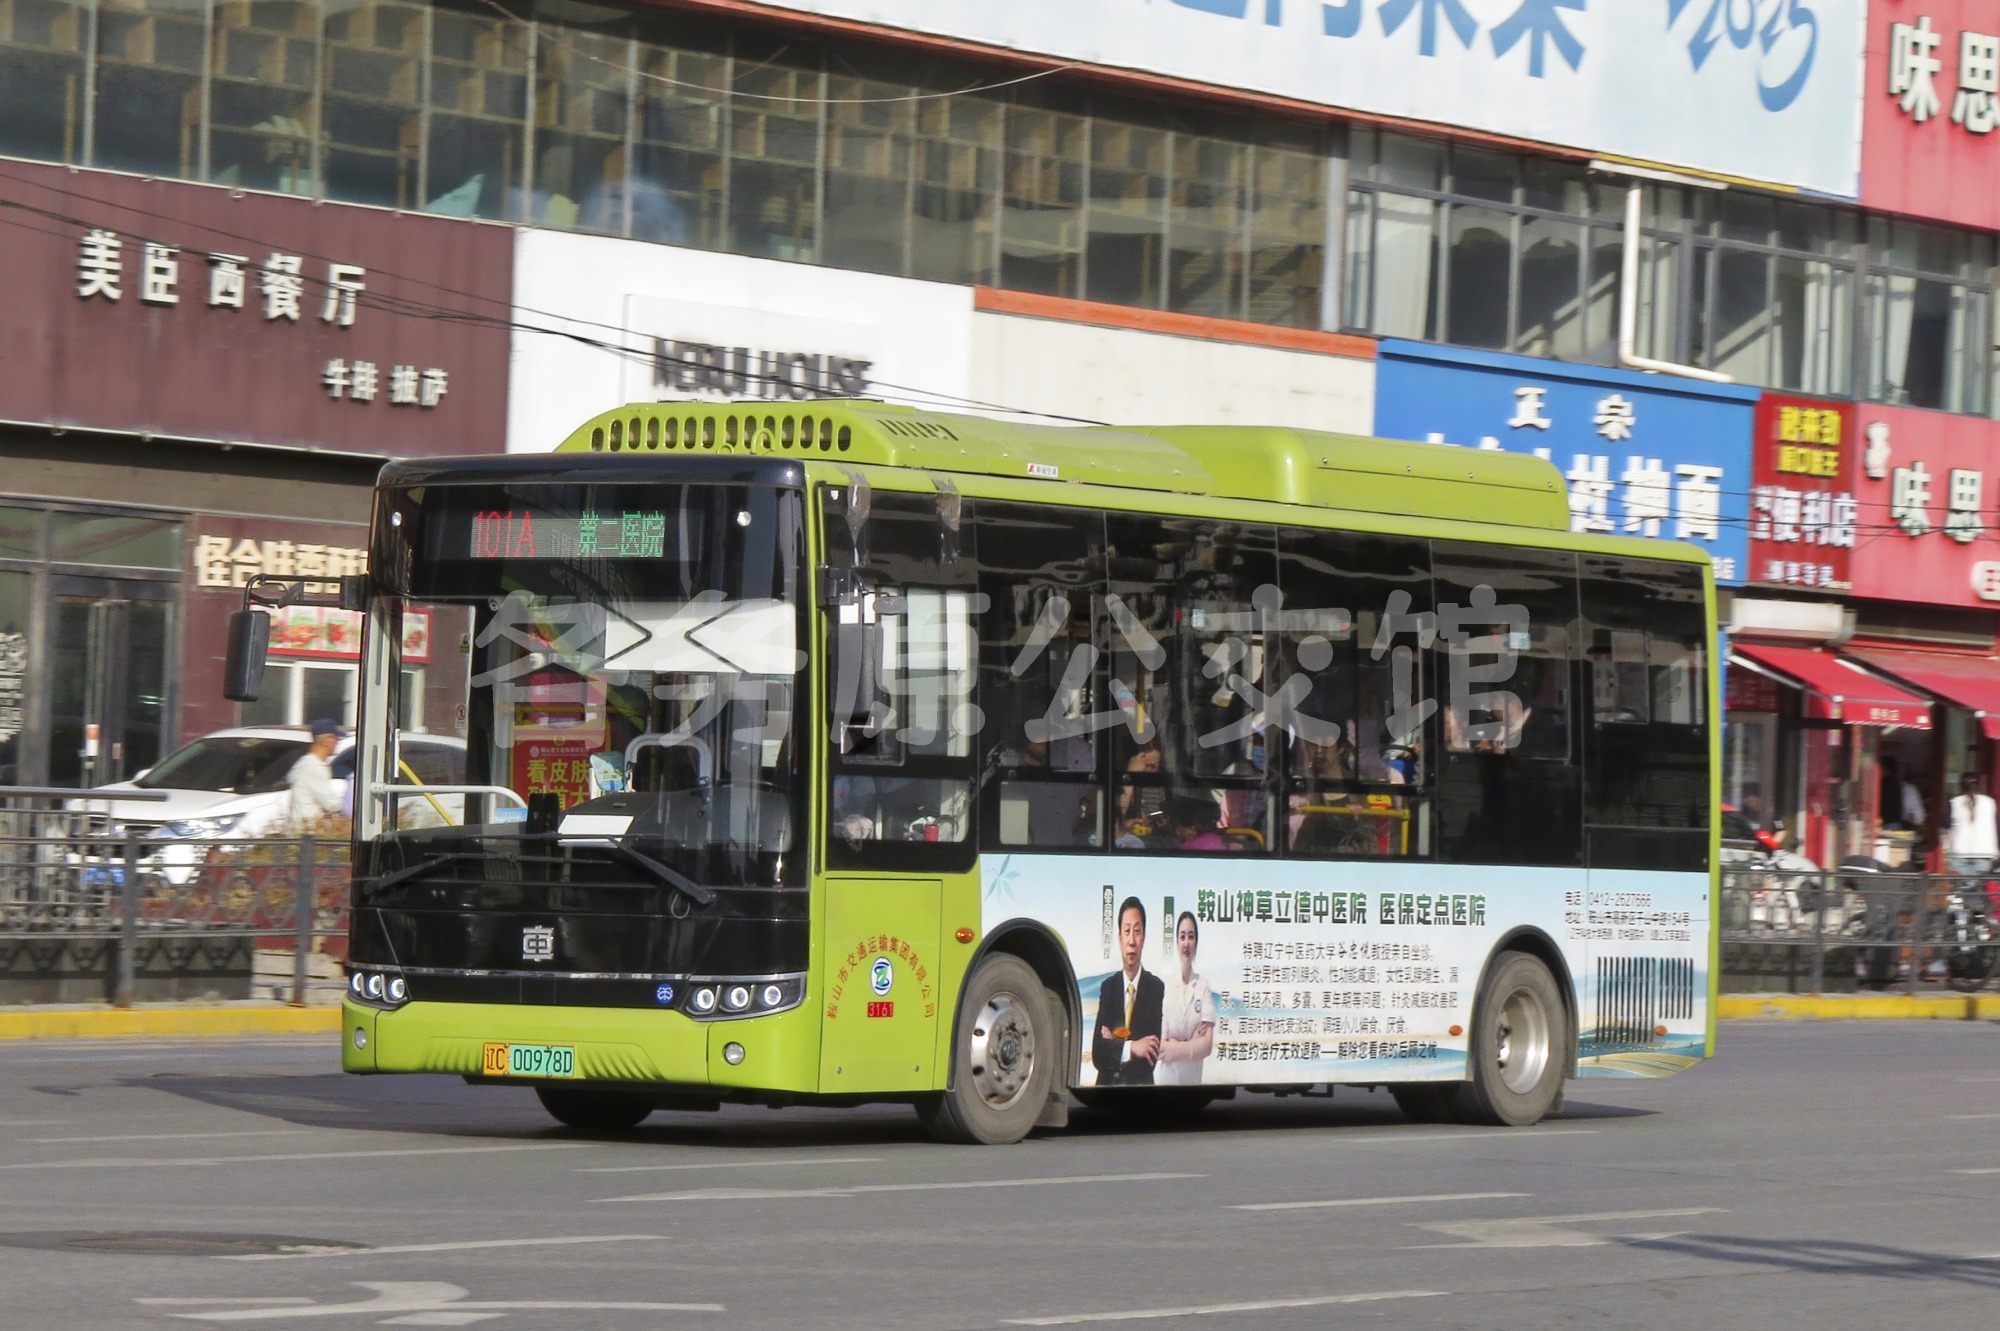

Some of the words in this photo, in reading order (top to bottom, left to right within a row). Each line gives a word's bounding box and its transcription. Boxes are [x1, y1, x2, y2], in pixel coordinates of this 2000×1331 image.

[1889, 15, 2000, 134] 味思
[78, 229, 366, 326] 美臣西餐厅
[323, 358, 379, 400] 牛排
[390, 365, 448, 407] 披萨
[1507, 386, 1637, 441] 正宗
[1772, 487, 1858, 547] 便利店
[1892, 461, 1985, 543] 味思
[475, 511, 536, 557] 101A
[578, 511, 665, 557] 第二医院
[527, 759, 589, 784] 看皮肤
[1197, 889, 1367, 924] 鞍山神草立德中医院
[1379, 892, 1486, 926] 医保定点医院
[868, 1002, 893, 1017] 3161
